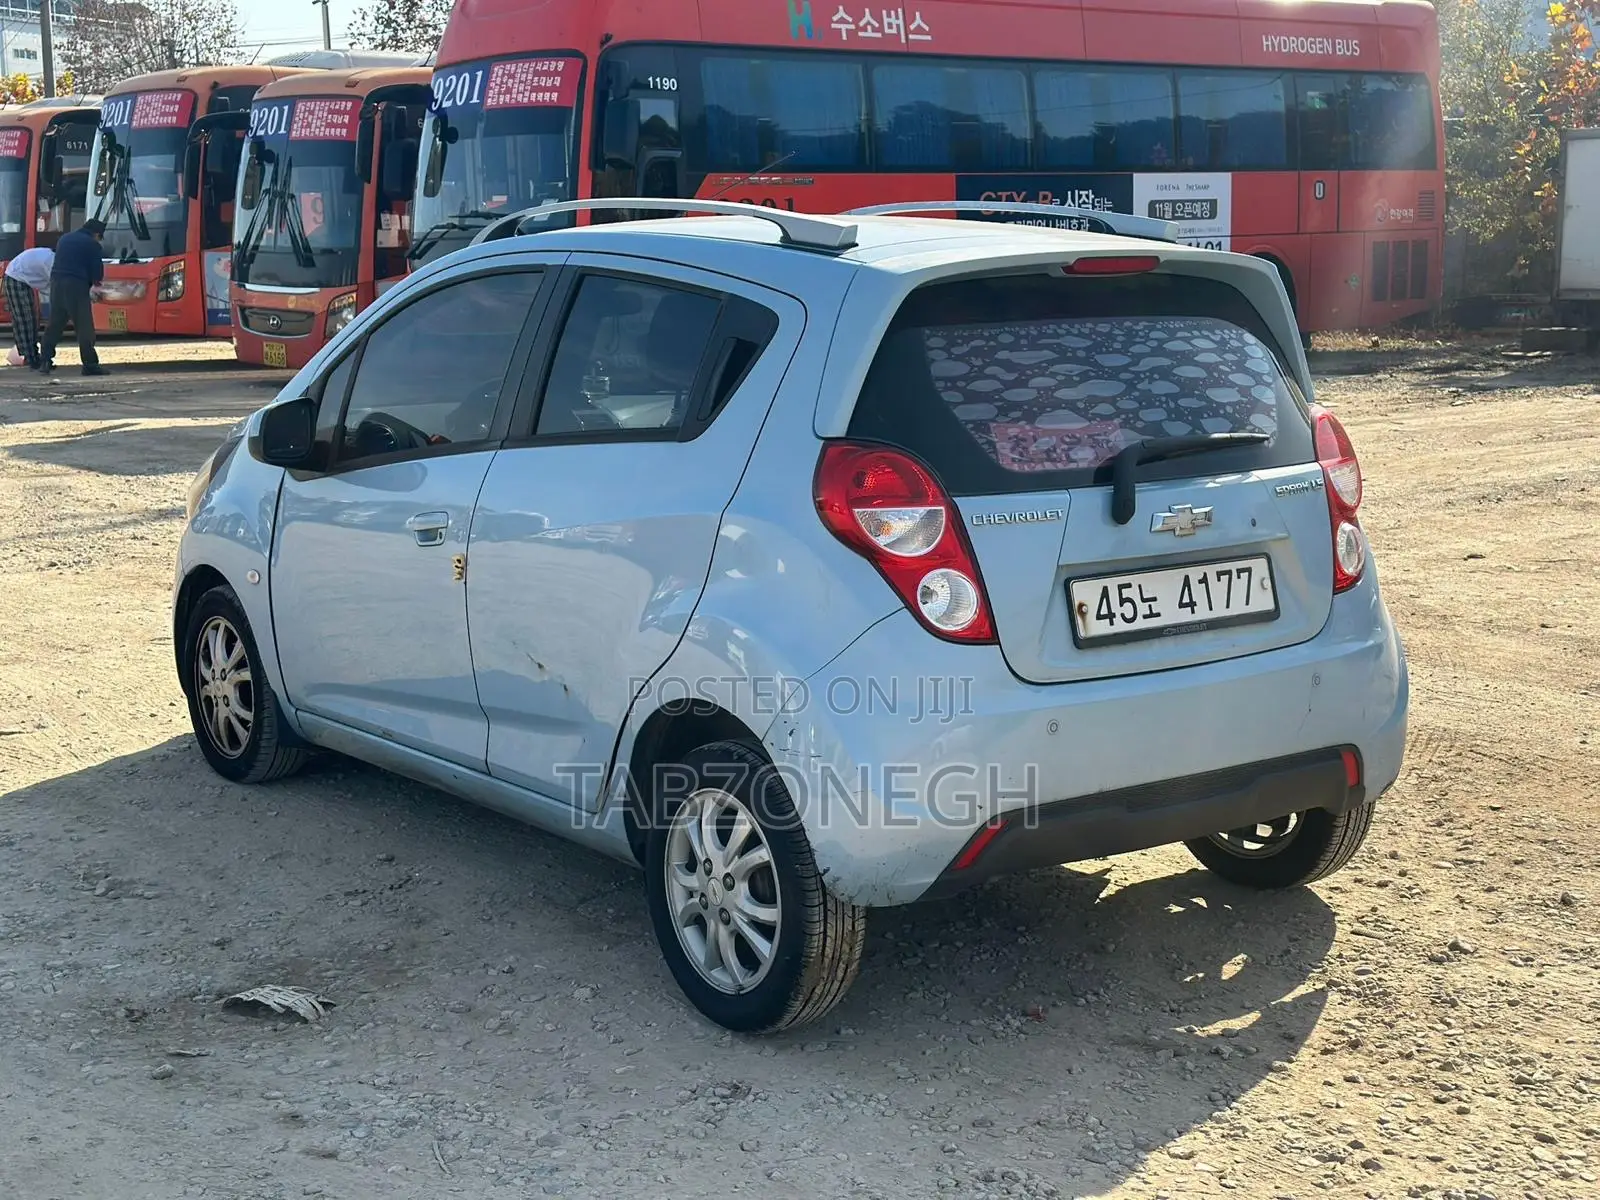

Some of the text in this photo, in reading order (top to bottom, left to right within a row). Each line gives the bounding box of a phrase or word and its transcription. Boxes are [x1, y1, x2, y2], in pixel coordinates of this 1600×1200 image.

[831, 5, 932, 43] 수소버스
[1262, 34, 1360, 56] HYDROGEN BUS
[432, 70, 483, 111] 9201
[648, 76, 678, 91] 1190
[100, 99, 132, 129] 9201
[248, 105, 289, 137] 9201
[66, 141, 88, 150] 6171
[1155, 202, 1210, 219] 11월 오픈예정
[972, 508, 1064, 526] CHEVROLET
[1096, 567, 1253, 627] 45노 4177
